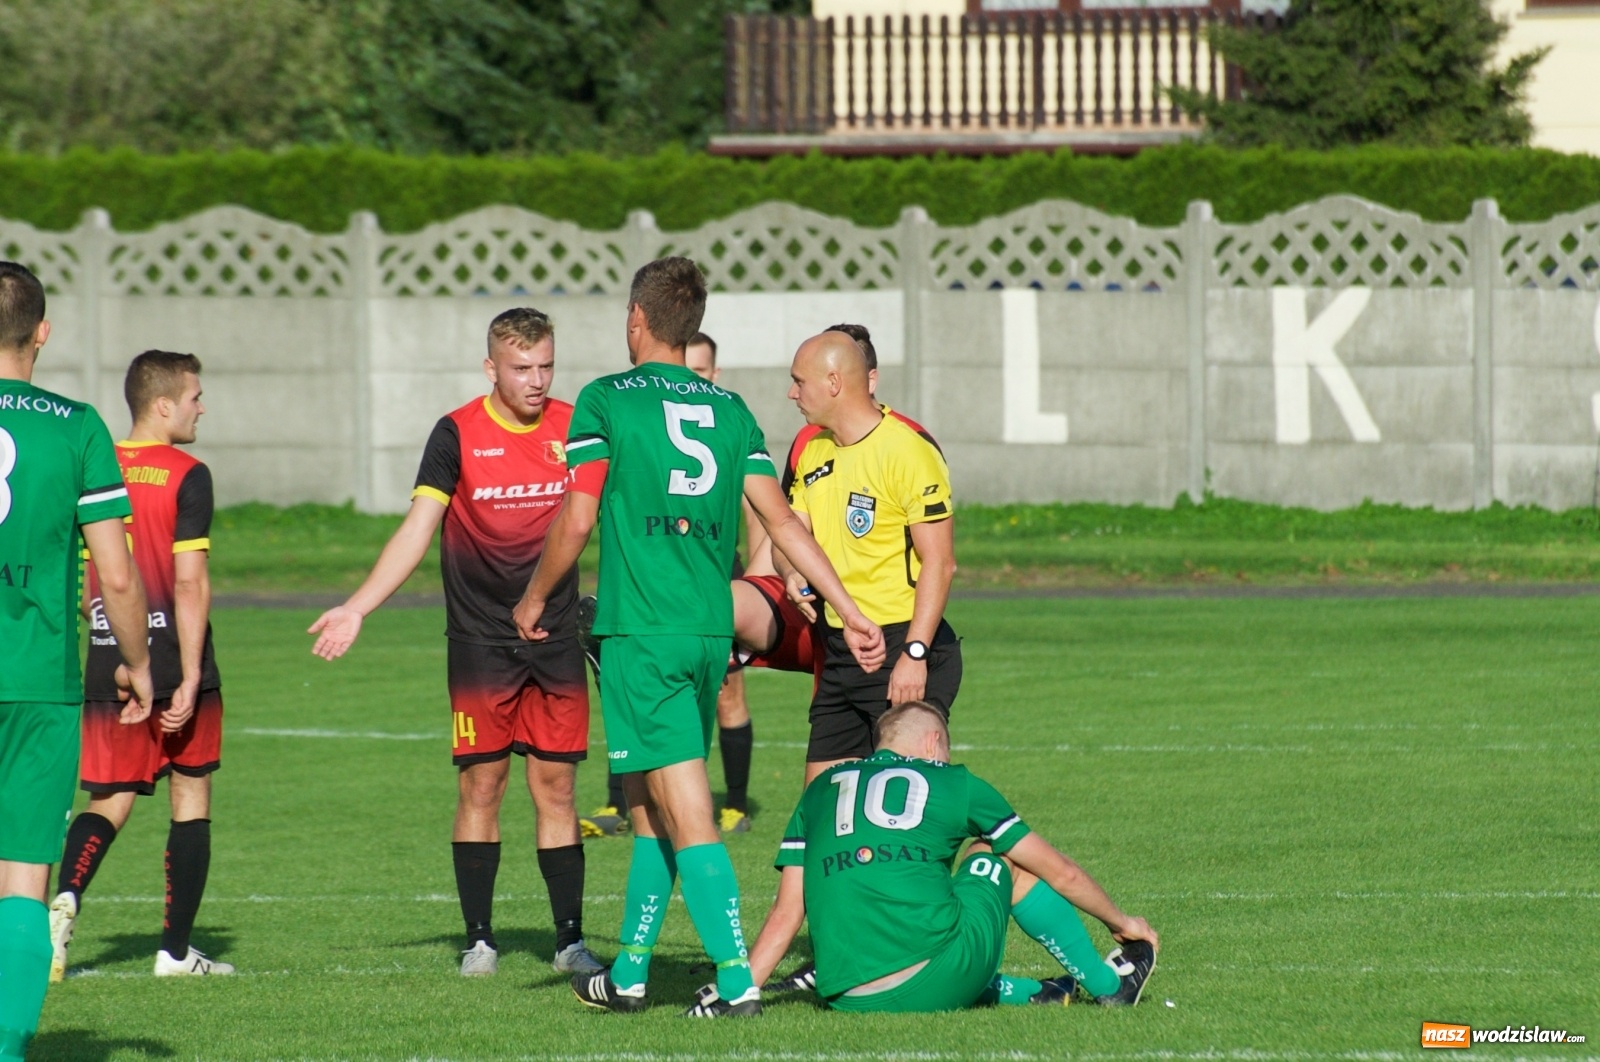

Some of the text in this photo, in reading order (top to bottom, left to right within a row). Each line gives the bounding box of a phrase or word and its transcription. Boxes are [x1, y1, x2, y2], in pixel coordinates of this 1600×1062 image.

[613, 376, 647, 390] LKS
[0, 394, 72, 418] RKÓW
[482, 448, 504, 457] VIGO
[661, 399, 718, 497] 5
[453, 711, 476, 748] 14
[830, 767, 930, 837] 10
[821, 843, 931, 877] PROSAT
